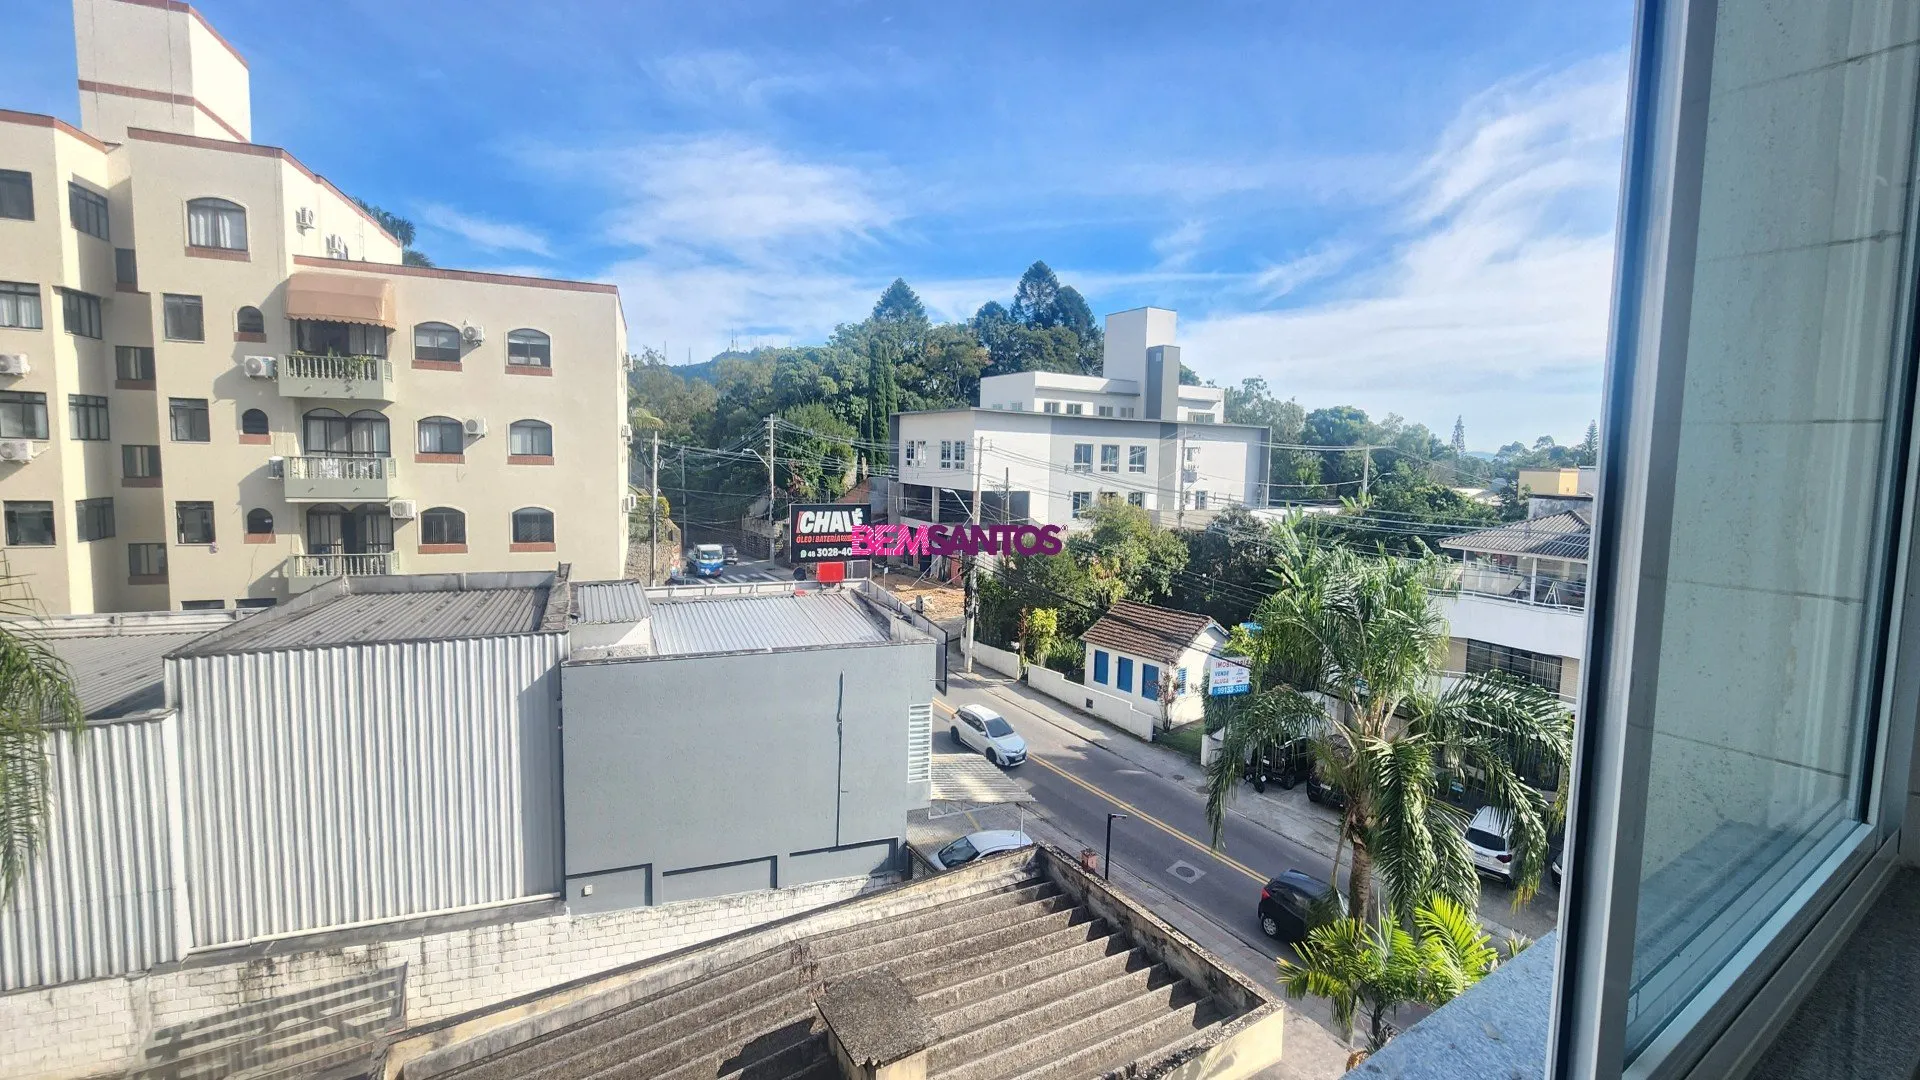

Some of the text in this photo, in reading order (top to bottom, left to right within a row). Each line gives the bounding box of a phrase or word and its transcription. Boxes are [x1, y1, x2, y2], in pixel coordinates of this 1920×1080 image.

[799, 508, 863, 533] CHALÉ
[807, 547, 852, 558] 48 3028-40
